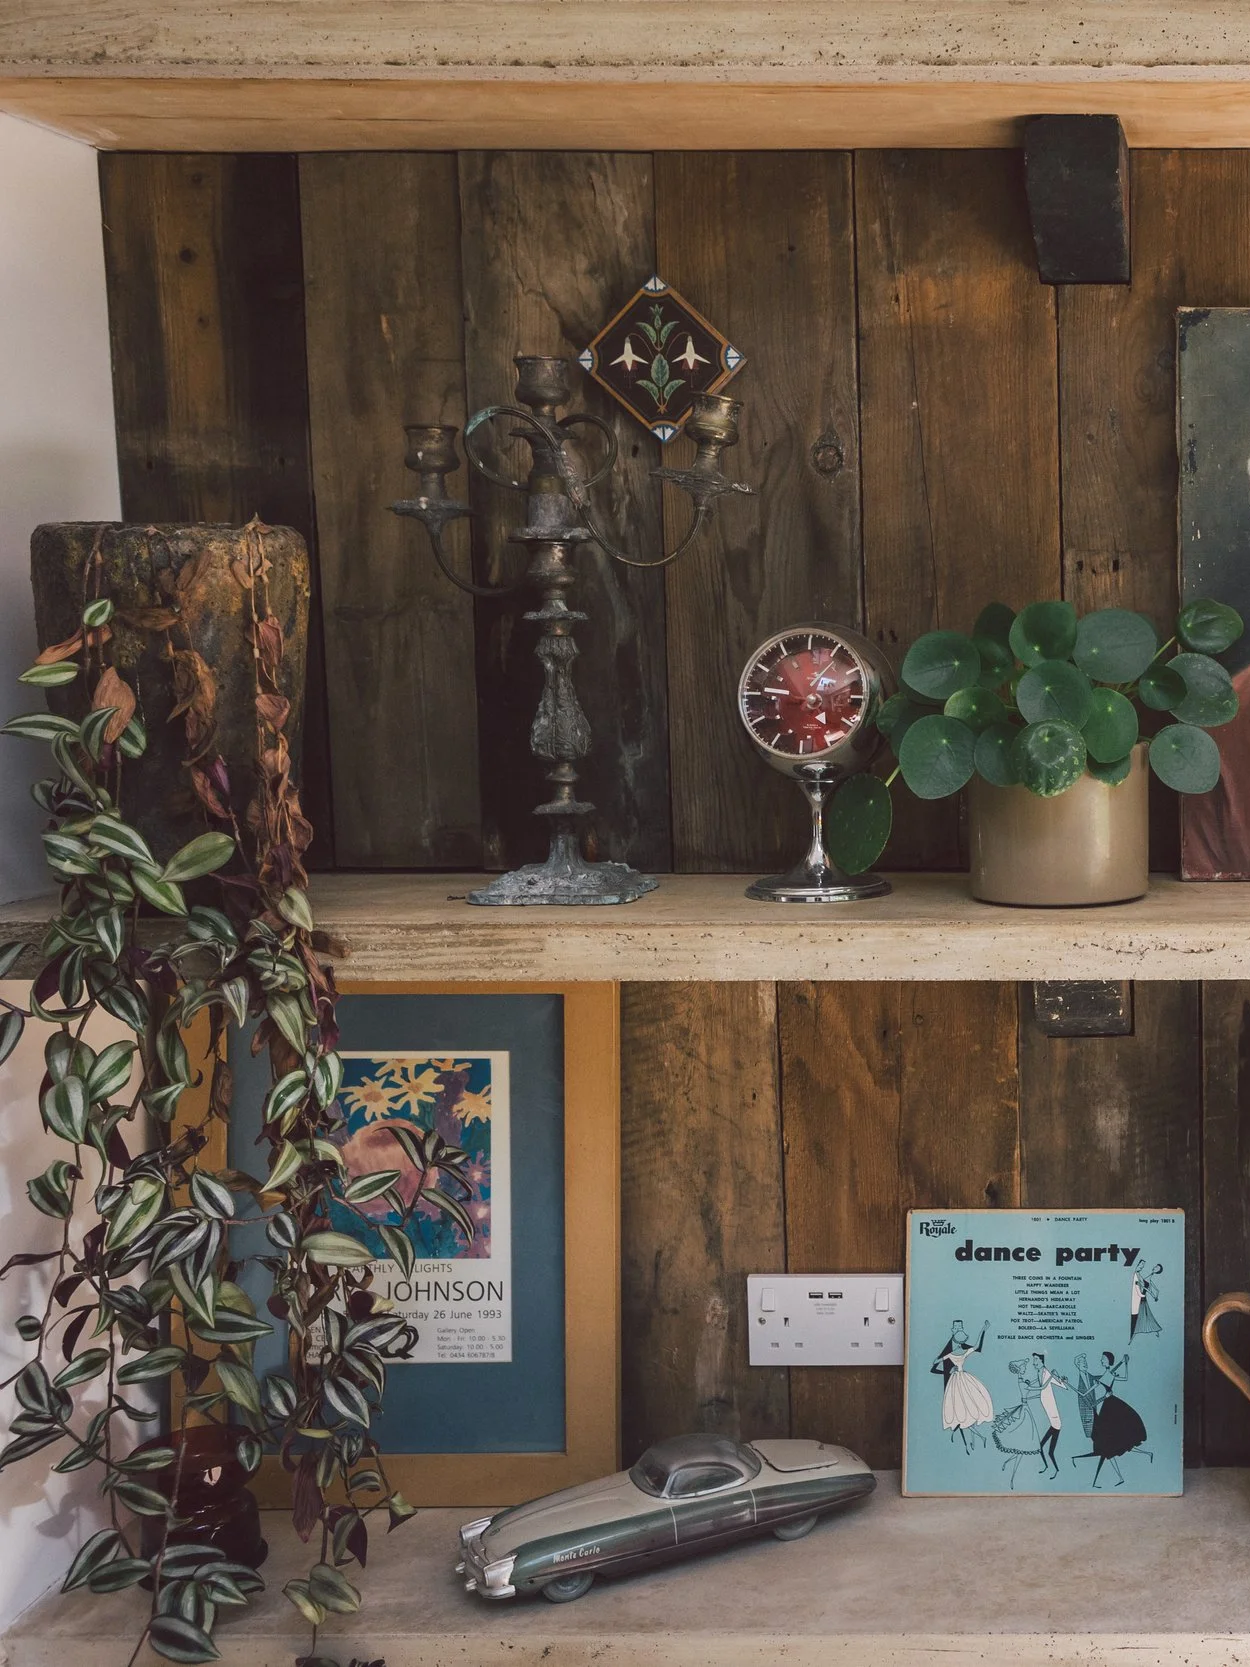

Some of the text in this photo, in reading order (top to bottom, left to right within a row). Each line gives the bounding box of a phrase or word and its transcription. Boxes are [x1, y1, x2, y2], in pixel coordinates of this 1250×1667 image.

[920, 1222, 957, 1238] Royale
[955, 1240, 1140, 1266] dance party
[414, 1264, 453, 1273] LIGHTS
[387, 1280, 504, 1302] JOHNSON
[433, 1310, 446, 1320] 26
[450, 1310, 472, 1320] June
[478, 1310, 502, 1320] 1993
[553, 1546, 600, 1564] Monte Carlo
